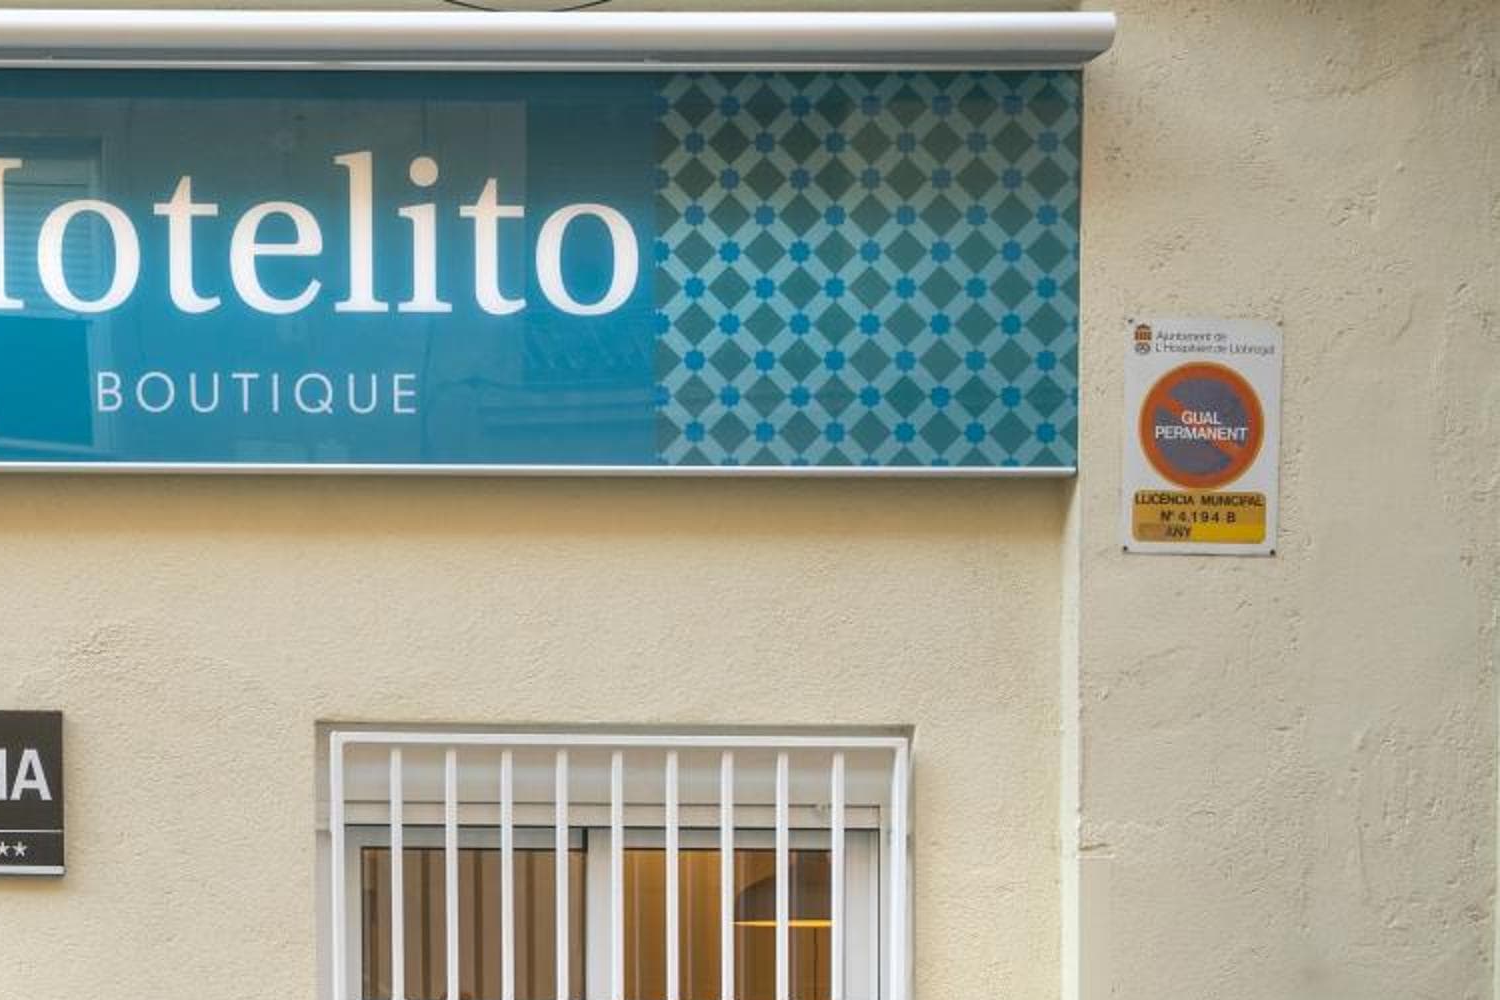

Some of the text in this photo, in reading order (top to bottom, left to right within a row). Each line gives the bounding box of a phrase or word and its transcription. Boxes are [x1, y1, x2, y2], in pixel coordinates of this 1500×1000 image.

[97, 372, 417, 417] BOUTIQUE
[1181, 410, 1221, 425] GUAL
[1155, 425, 1248, 441] PERMANENT
[1201, 495, 1263, 507] MUNICIPAL
